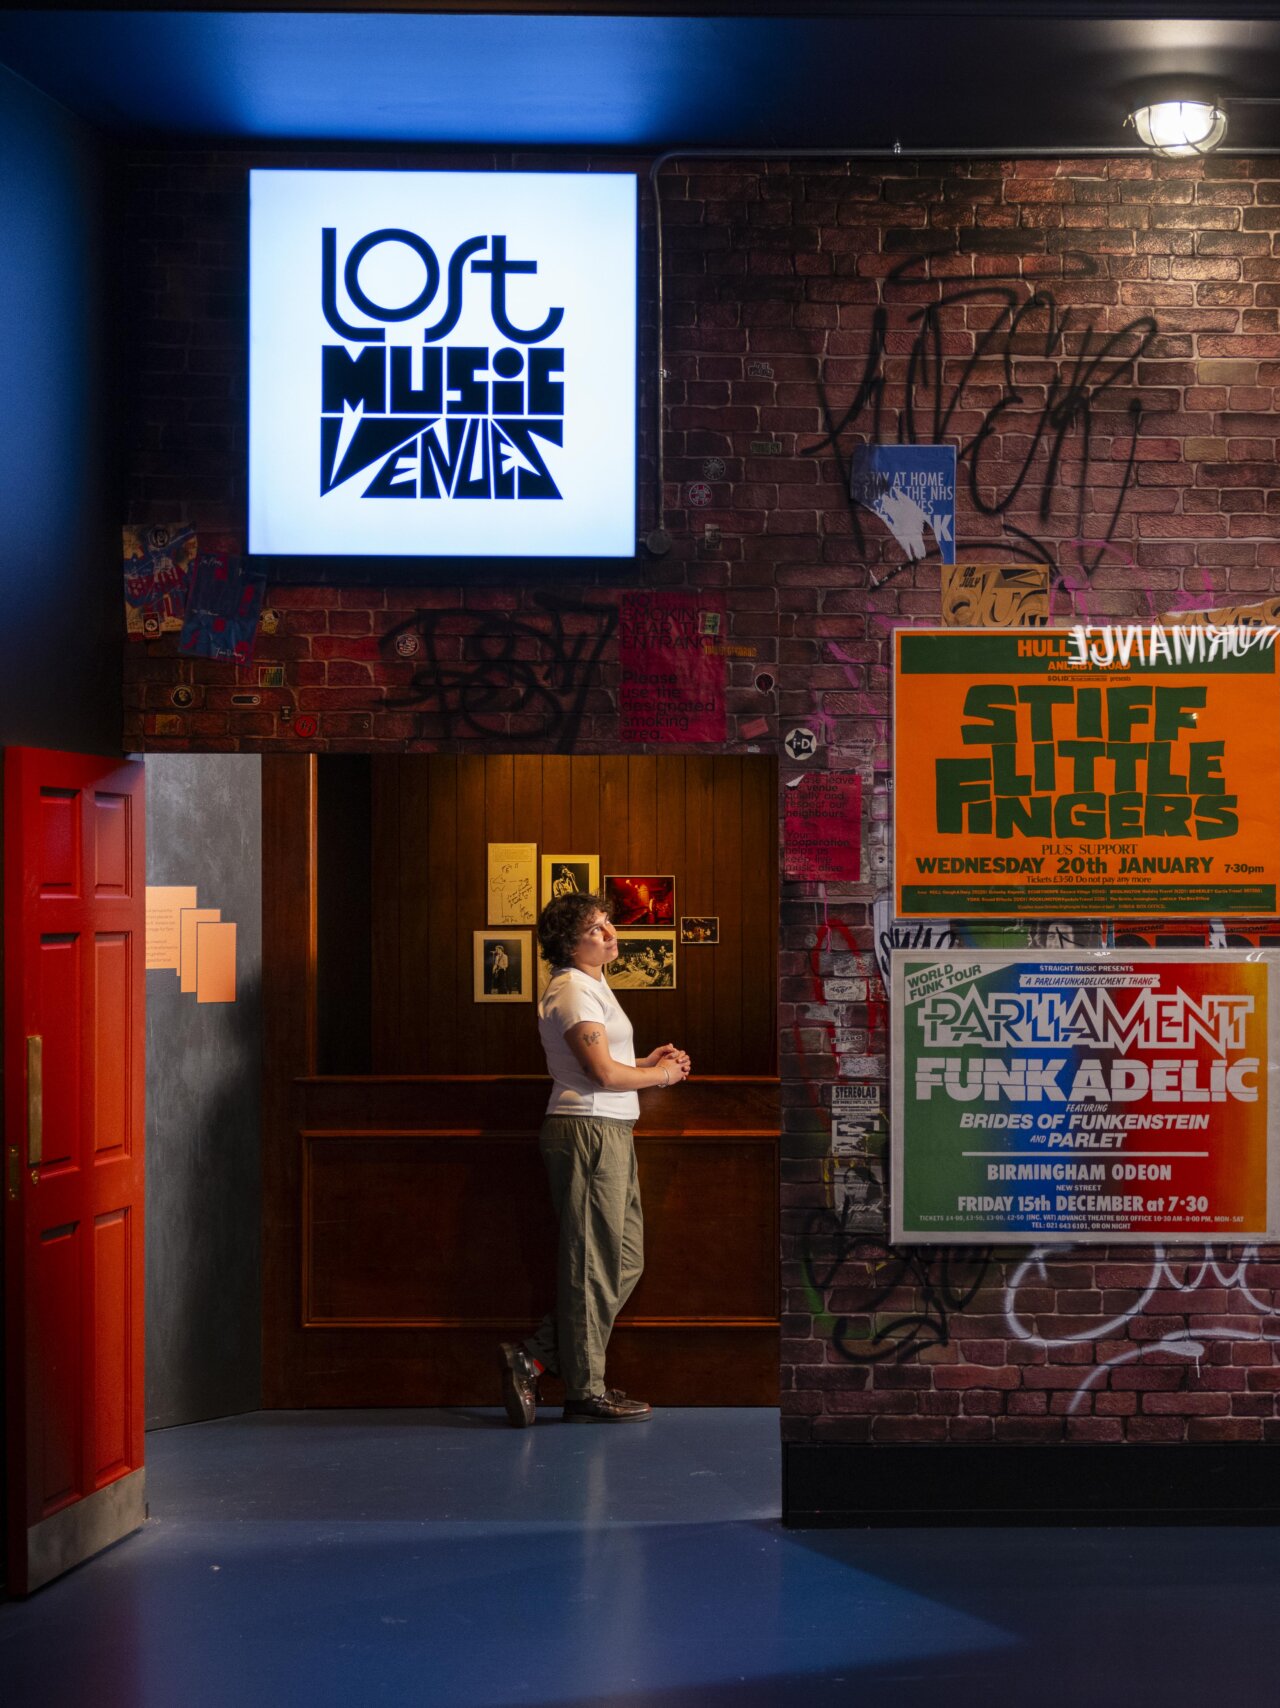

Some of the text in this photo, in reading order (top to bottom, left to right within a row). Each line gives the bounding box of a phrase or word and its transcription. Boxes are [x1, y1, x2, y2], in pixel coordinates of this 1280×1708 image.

[320, 417, 564, 500] VENUES
[893, 471, 907, 486] AT
[910, 471, 944, 486] HOME
[906, 486, 926, 501] THE
[930, 486, 953, 500] NHS
[622, 593, 649, 607] NO
[622, 608, 711, 622] SMOKIN
[622, 621, 673, 635] NEAR
[622, 635, 724, 649] ENTRANCE
[1017, 639, 1072, 657] HULL
[623, 671, 678, 685] Please
[622, 687, 681, 698] use the
[622, 698, 716, 716] designated
[961, 684, 1208, 745] STIFF
[623, 712, 689, 731] smoking
[991, 740, 1226, 797] LITTLE
[935, 757, 1239, 841] FINGERS
[786, 831, 810, 839] Your
[1041, 843, 1138, 855] PLUS SUPPORT
[916, 857, 1045, 874] WEDNESDAY
[1056, 857, 1108, 874] 20th
[1118, 857, 1214, 874] JANUARY
[1026, 875, 1053, 884] Tickets
[1075, 875, 1087, 884] Do
[1088, 876, 1101, 884] not
[1102, 877, 1115, 886] pay
[1116, 877, 1130, 886] any
[907, 963, 954, 989] WORLD
[909, 964, 982, 1001] FUNK TOUR
[918, 984, 1255, 1057] PARLIAMENT
[835, 1086, 877, 1099] STEREOLAB
[1065, 1104, 1108, 1113] FEATURING
[959, 1113, 1210, 1130] BRIDES OF FUNKENSTEIN
[1030, 1132, 1128, 1148] AND PARLET
[987, 1164, 1172, 1181] BIRMINGHAM ODEON
[1056, 1184, 1102, 1192] NEW STREET
[957, 1195, 1014, 1212] FRIDAY
[1018, 1195, 1051, 1212] 15th
[1056, 1195, 1144, 1212] DECEMBER
[1146, 1195, 1165, 1212] at
